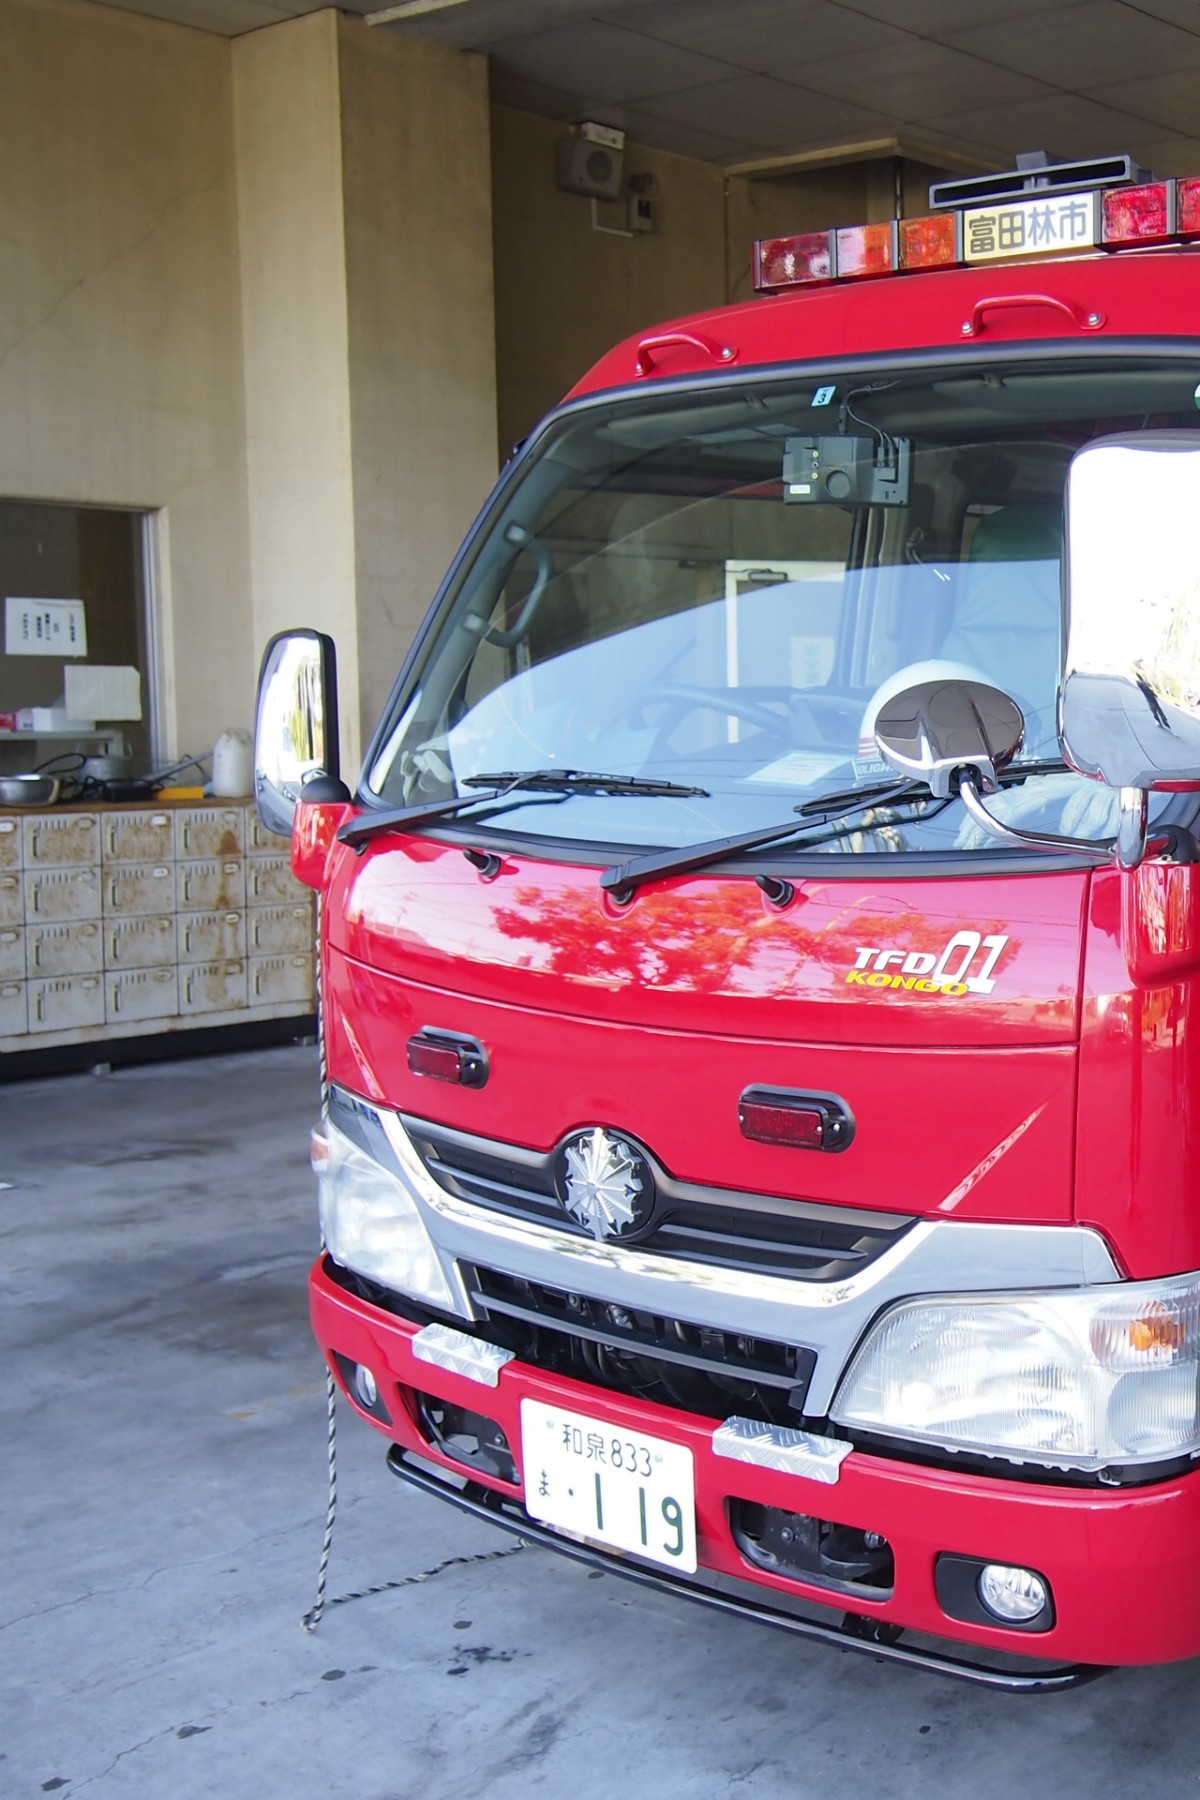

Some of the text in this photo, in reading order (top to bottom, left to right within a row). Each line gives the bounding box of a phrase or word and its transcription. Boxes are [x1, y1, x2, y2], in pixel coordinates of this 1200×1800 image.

[969, 201, 1088, 254] 富田林市
[845, 970, 969, 996] KONGO
[854, 930, 1009, 995] TFD 01
